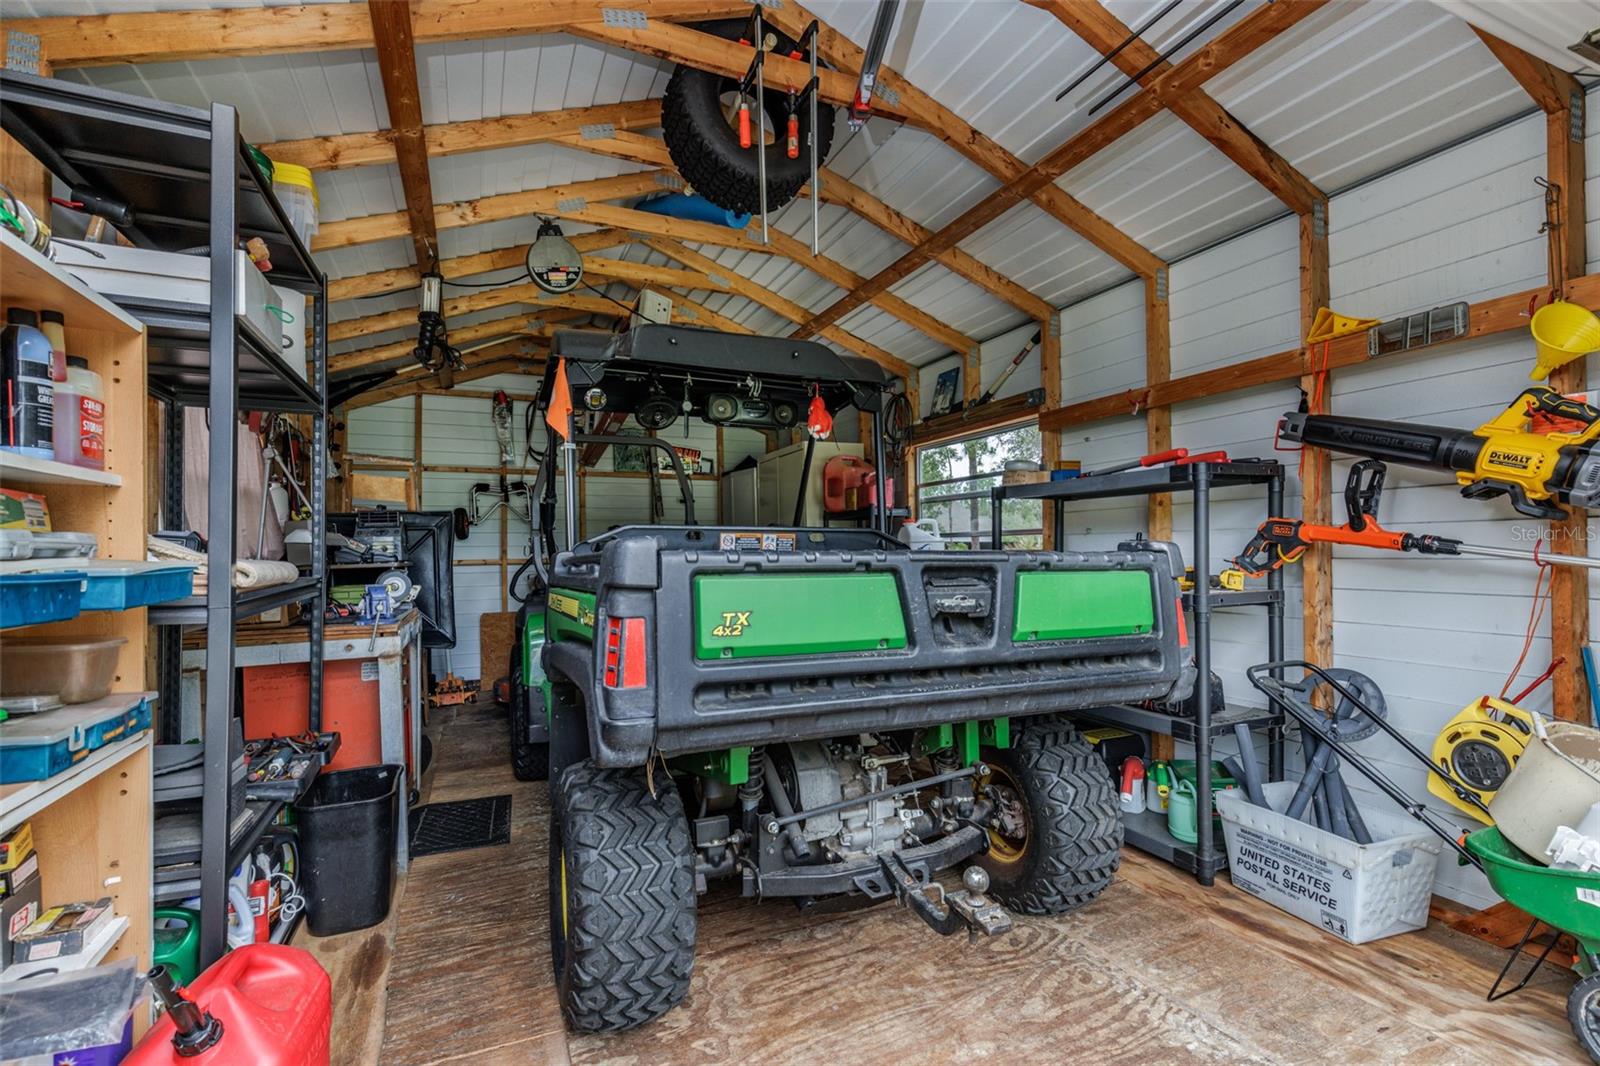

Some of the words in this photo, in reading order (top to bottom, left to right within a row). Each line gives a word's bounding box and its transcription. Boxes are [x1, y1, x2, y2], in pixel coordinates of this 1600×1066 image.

[712, 625, 742, 637] 4x2
[722, 611, 751, 627] TX
[1240, 828, 1264, 841] WARNING
[1267, 838, 1279, 848] NOT
[1279, 843, 1291, 852] FOR
[1291, 846, 1314, 862] PRIVATE
[1314, 857, 1328, 867] USE
[1236, 857, 1280, 884] POSTAL
[1282, 878, 1338, 910] SERVICE
[1240, 846, 1280, 870] UNITED
[1282, 864, 1332, 893] STATES
